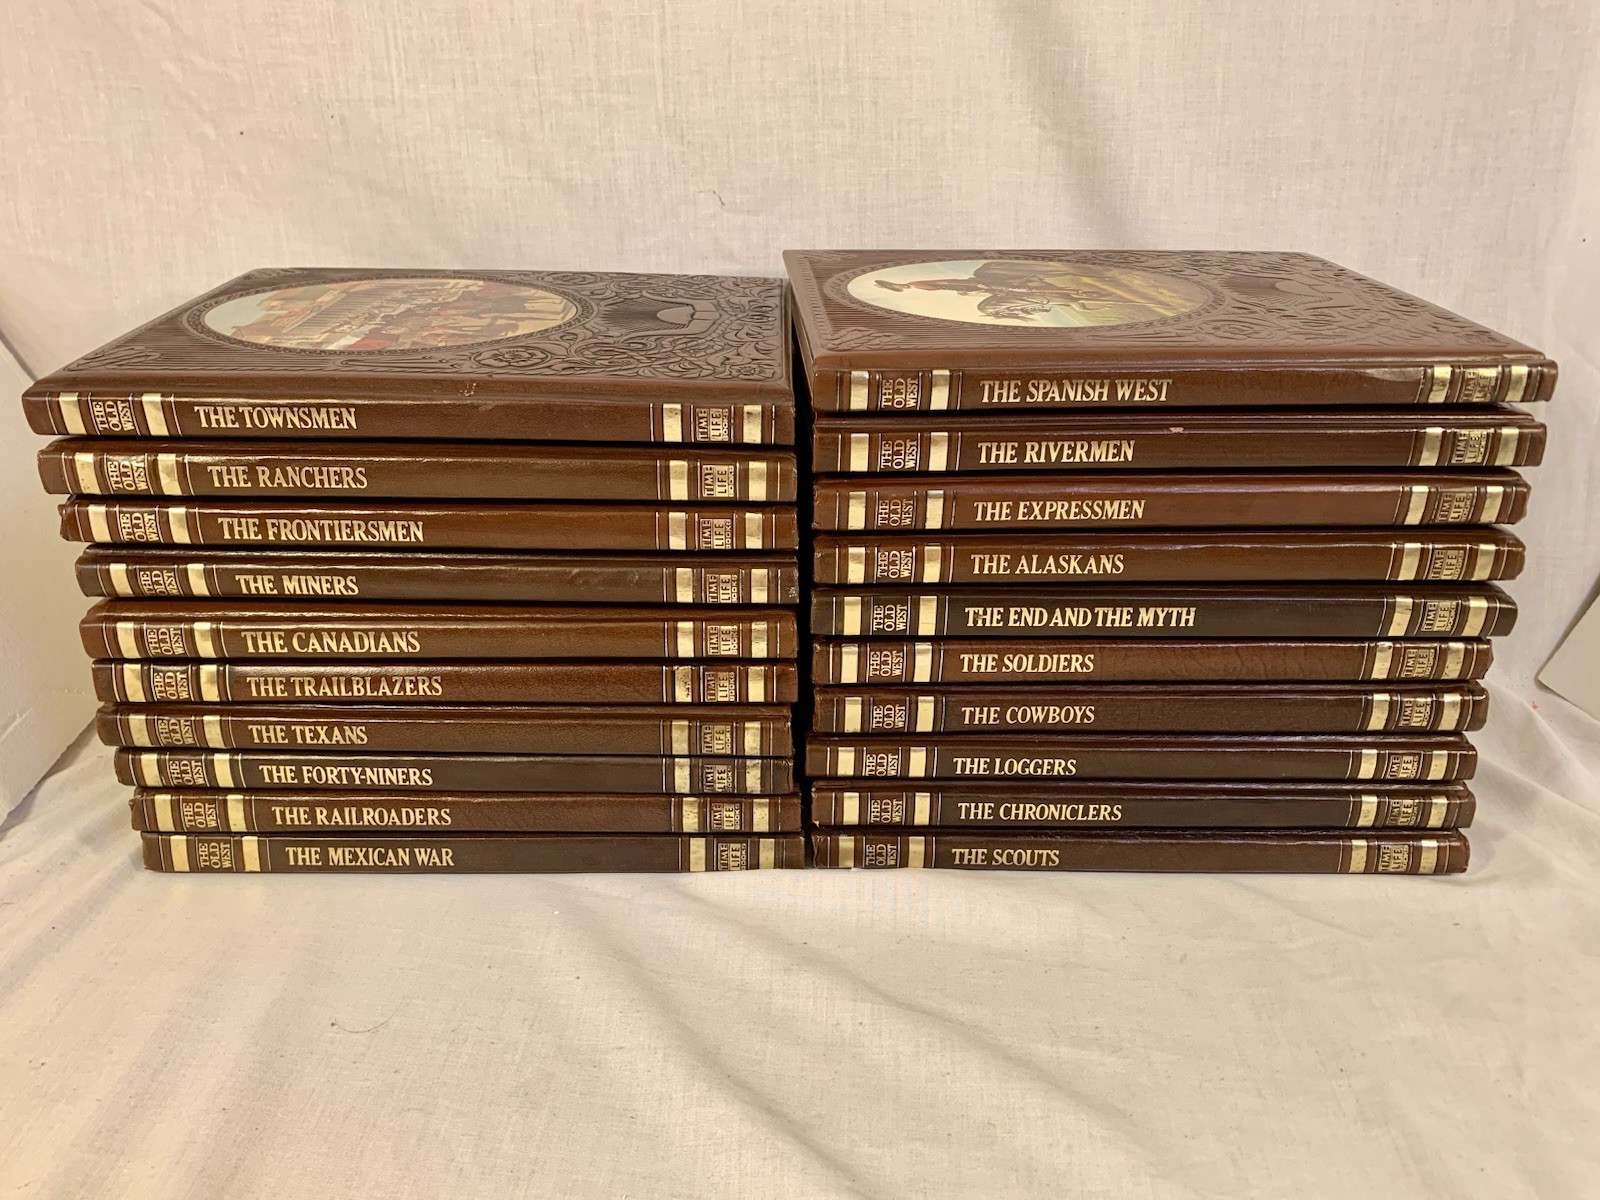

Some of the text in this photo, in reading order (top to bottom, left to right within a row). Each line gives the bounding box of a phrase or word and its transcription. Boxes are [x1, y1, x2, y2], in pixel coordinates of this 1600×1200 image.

[882, 379, 893, 408] THE
[893, 378, 906, 408] OLD
[906, 378, 919, 408] WEST
[979, 378, 1173, 404] THE SPANISH WEST
[93, 401, 107, 430] THE
[105, 401, 121, 431] OLD
[118, 401, 136, 431] WEST
[193, 406, 358, 430] THE TOWNSMEN
[711, 410, 721, 437] LIFE
[881, 441, 892, 468] THE
[892, 440, 905, 469] OLD
[905, 440, 918, 468] WEST
[977, 439, 1136, 464] THE RIVERMEN
[1467, 433, 1480, 462] LIFE
[108, 462, 124, 490] THE
[121, 460, 135, 491] OLD
[132, 459, 148, 491] WEST
[207, 465, 368, 489] THE RANCHERS
[717, 470, 727, 494] LIFE
[878, 500, 889, 526] THE
[889, 499, 902, 526] OLD
[901, 499, 914, 526] WEST
[973, 499, 1146, 522] THE EXPRESSMEN
[1450, 496, 1465, 521] LIFE
[120, 513, 134, 540] THE
[132, 513, 146, 542] OLD
[144, 513, 159, 541] WEST
[217, 516, 424, 543] THE FRONTIERSMEN
[715, 523, 724, 547] LIFE
[877, 552, 889, 577] THE
[888, 551, 900, 578] OLD
[900, 550, 913, 577] WEST
[970, 553, 1125, 575] THE ALASKANS
[1443, 554, 1457, 578] LIFE
[140, 571, 154, 595] THE
[152, 570, 167, 595] OLD
[163, 570, 178, 595] WEST
[235, 574, 360, 596] THE MINERS
[721, 578, 731, 601] LIFE
[873, 606, 884, 630] THE
[883, 604, 896, 631] OLD
[896, 605, 908, 631] WEST
[964, 606, 1197, 628] THE END AND THE MYTH
[1436, 606, 1449, 628] LIFE
[147, 629, 161, 653] THE
[158, 628, 172, 655] OLD
[170, 629, 184, 654] WEST
[241, 630, 421, 654] THE CANADIANS
[721, 629, 731, 652] LIFE
[870, 652, 880, 676] THE
[880, 650, 892, 676] OLD
[892, 651, 903, 676] WEST
[960, 653, 1095, 674] THE SOLDIERS
[1416, 652, 1427, 676] LIFE
[154, 673, 165, 699] THE
[164, 672, 176, 699] OLD
[176, 672, 189, 700] WEST
[247, 675, 443, 697] THE TRAILBLAZERS
[719, 675, 728, 698] LIFE
[873, 706, 883, 728] THE
[883, 705, 894, 729] OLD
[894, 705, 905, 728] WEST
[961, 705, 1096, 725] THE COWBOYS
[1413, 702, 1424, 726] LIFE
[158, 719, 171, 744] THE
[169, 719, 183, 745] OLD
[181, 720, 195, 744] WEST
[248, 724, 368, 745] THE TEXANS
[716, 729, 725, 751] LIFE
[169, 761, 182, 784] THE
[181, 760, 194, 785] OLD
[191, 761, 205, 785] WEST
[259, 764, 434, 787] THE FORTY-NINERS
[866, 754, 876, 776] THE
[876, 753, 887, 776] OLD
[887, 754, 899, 776] WEST
[952, 757, 1077, 776] THE LOGGERS
[183, 803, 195, 827] THE
[194, 802, 206, 828] OLD
[206, 803, 218, 828] WEST
[271, 806, 453, 827] THE RAILROADERS
[725, 807, 734, 828] LIFE
[871, 800, 881, 822] THE
[881, 800, 892, 823] OLD
[892, 800, 903, 823] WEST
[957, 802, 1123, 821] THE CHRONICLERS
[1400, 803, 1411, 824] LIFE
[198, 843, 210, 868] THE
[210, 842, 220, 868] OLD
[220, 843, 232, 868] WEST
[284, 846, 455, 867] THE MEXICAN WAR
[732, 846, 740, 868] LIFE
[865, 845, 876, 865] THE
[875, 844, 887, 866] OLD
[887, 844, 897, 865] WEST
[951, 848, 1060, 867] THE SCOUTS
[1392, 849, 1402, 870] LIFE
